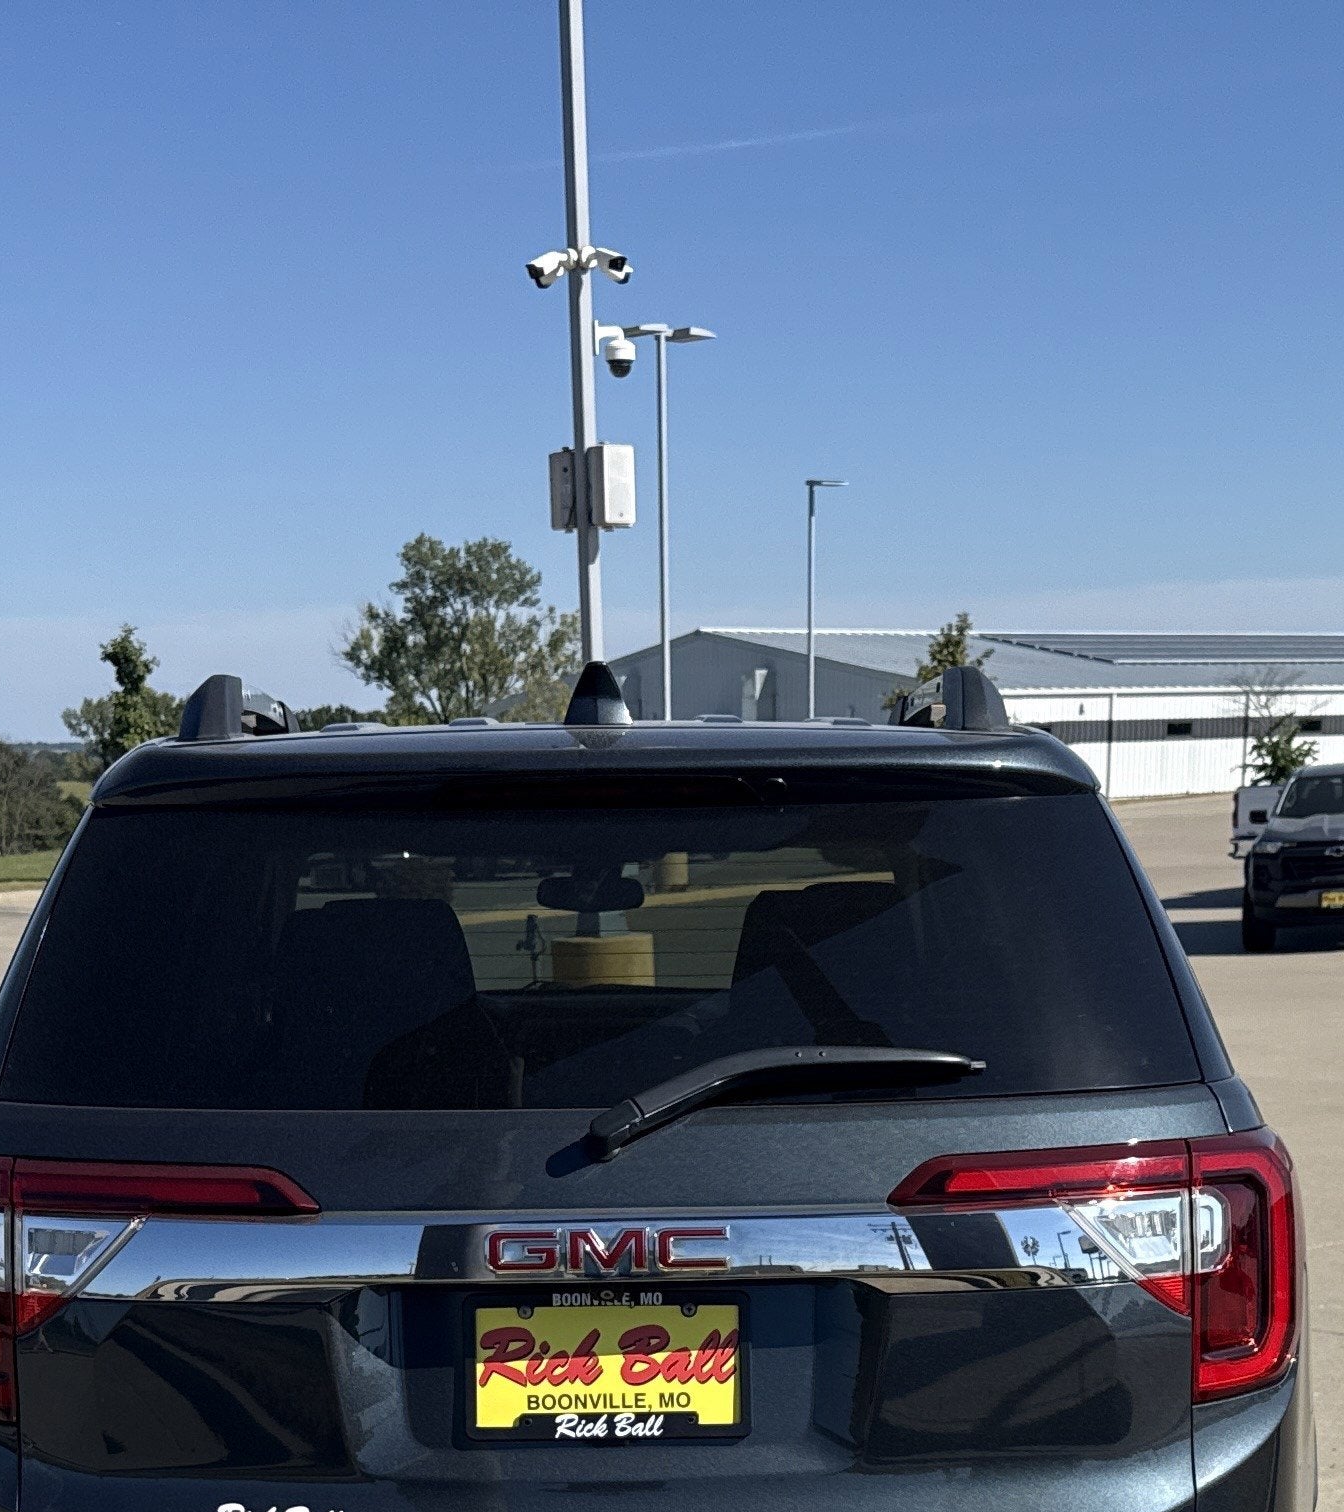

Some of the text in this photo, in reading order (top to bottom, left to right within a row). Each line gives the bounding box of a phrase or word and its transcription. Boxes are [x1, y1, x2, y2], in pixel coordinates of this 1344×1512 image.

[486, 1226, 731, 1274] GMC
[640, 1292, 663, 1306] MO
[479, 1324, 739, 1387] Rick Ball
[526, 1391, 691, 1413] BOONVILLE, MO
[554, 1412, 665, 1439] Rick Ball
